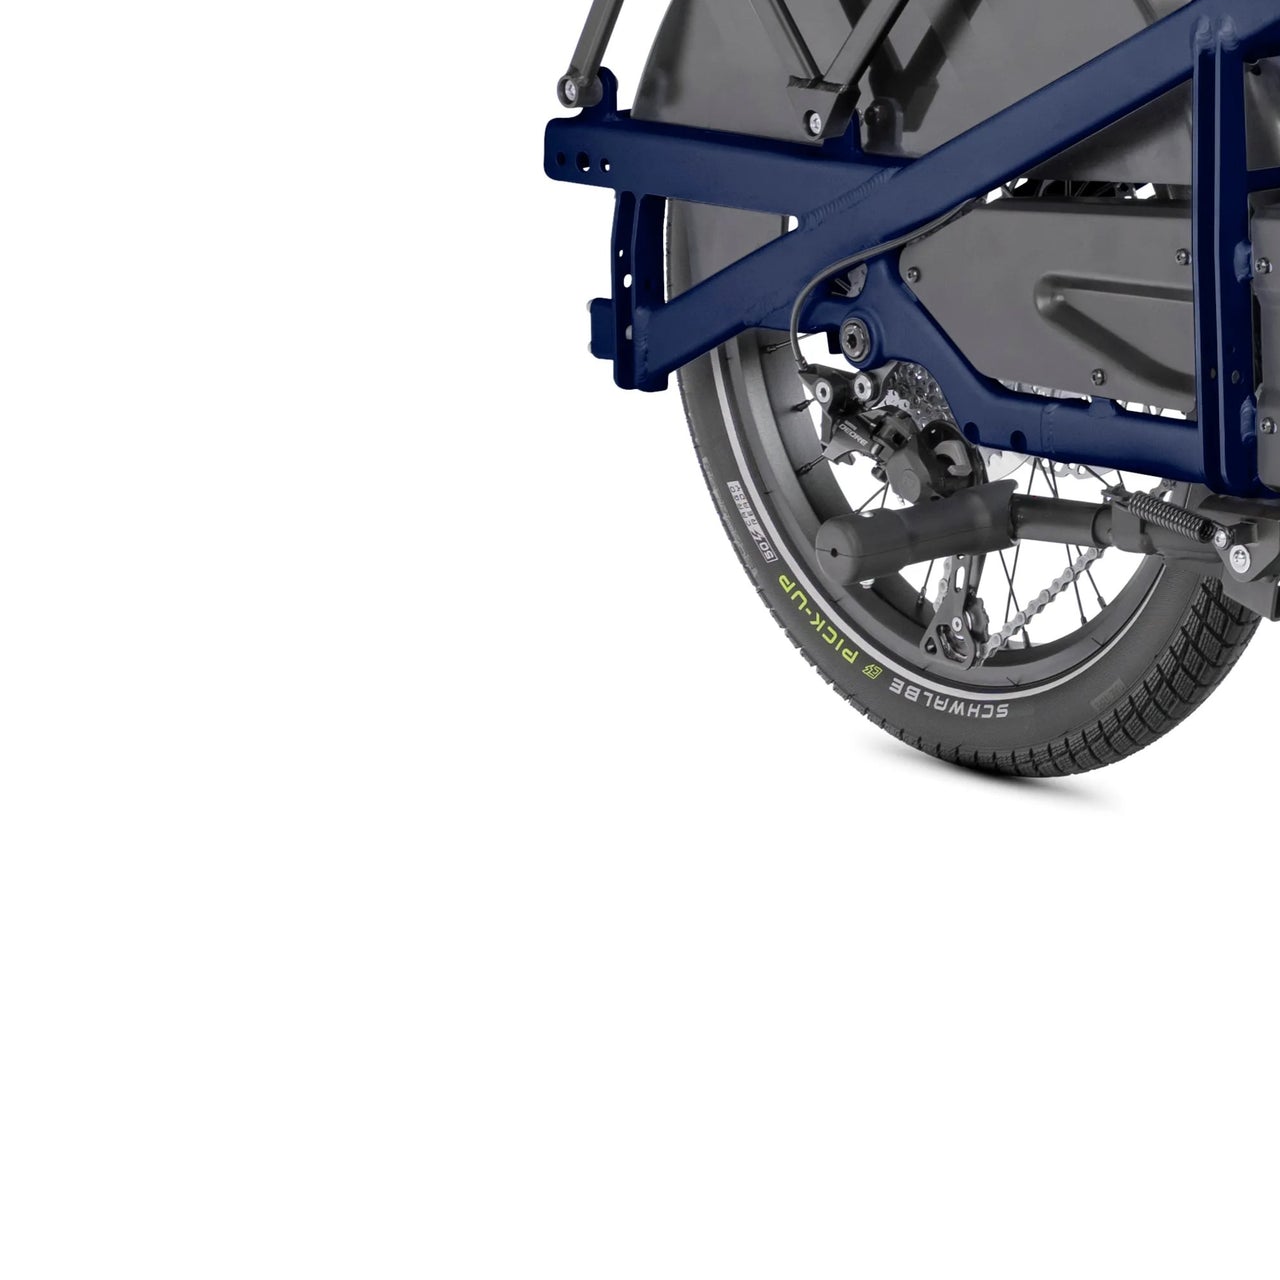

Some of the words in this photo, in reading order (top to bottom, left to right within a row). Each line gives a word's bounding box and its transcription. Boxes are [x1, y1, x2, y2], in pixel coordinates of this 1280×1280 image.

[839, 423, 868, 446] DEORE
[758, 541, 775, 561] 50
[779, 575, 860, 665] PICK-UP
[888, 677, 1010, 720] SCHWALBE
